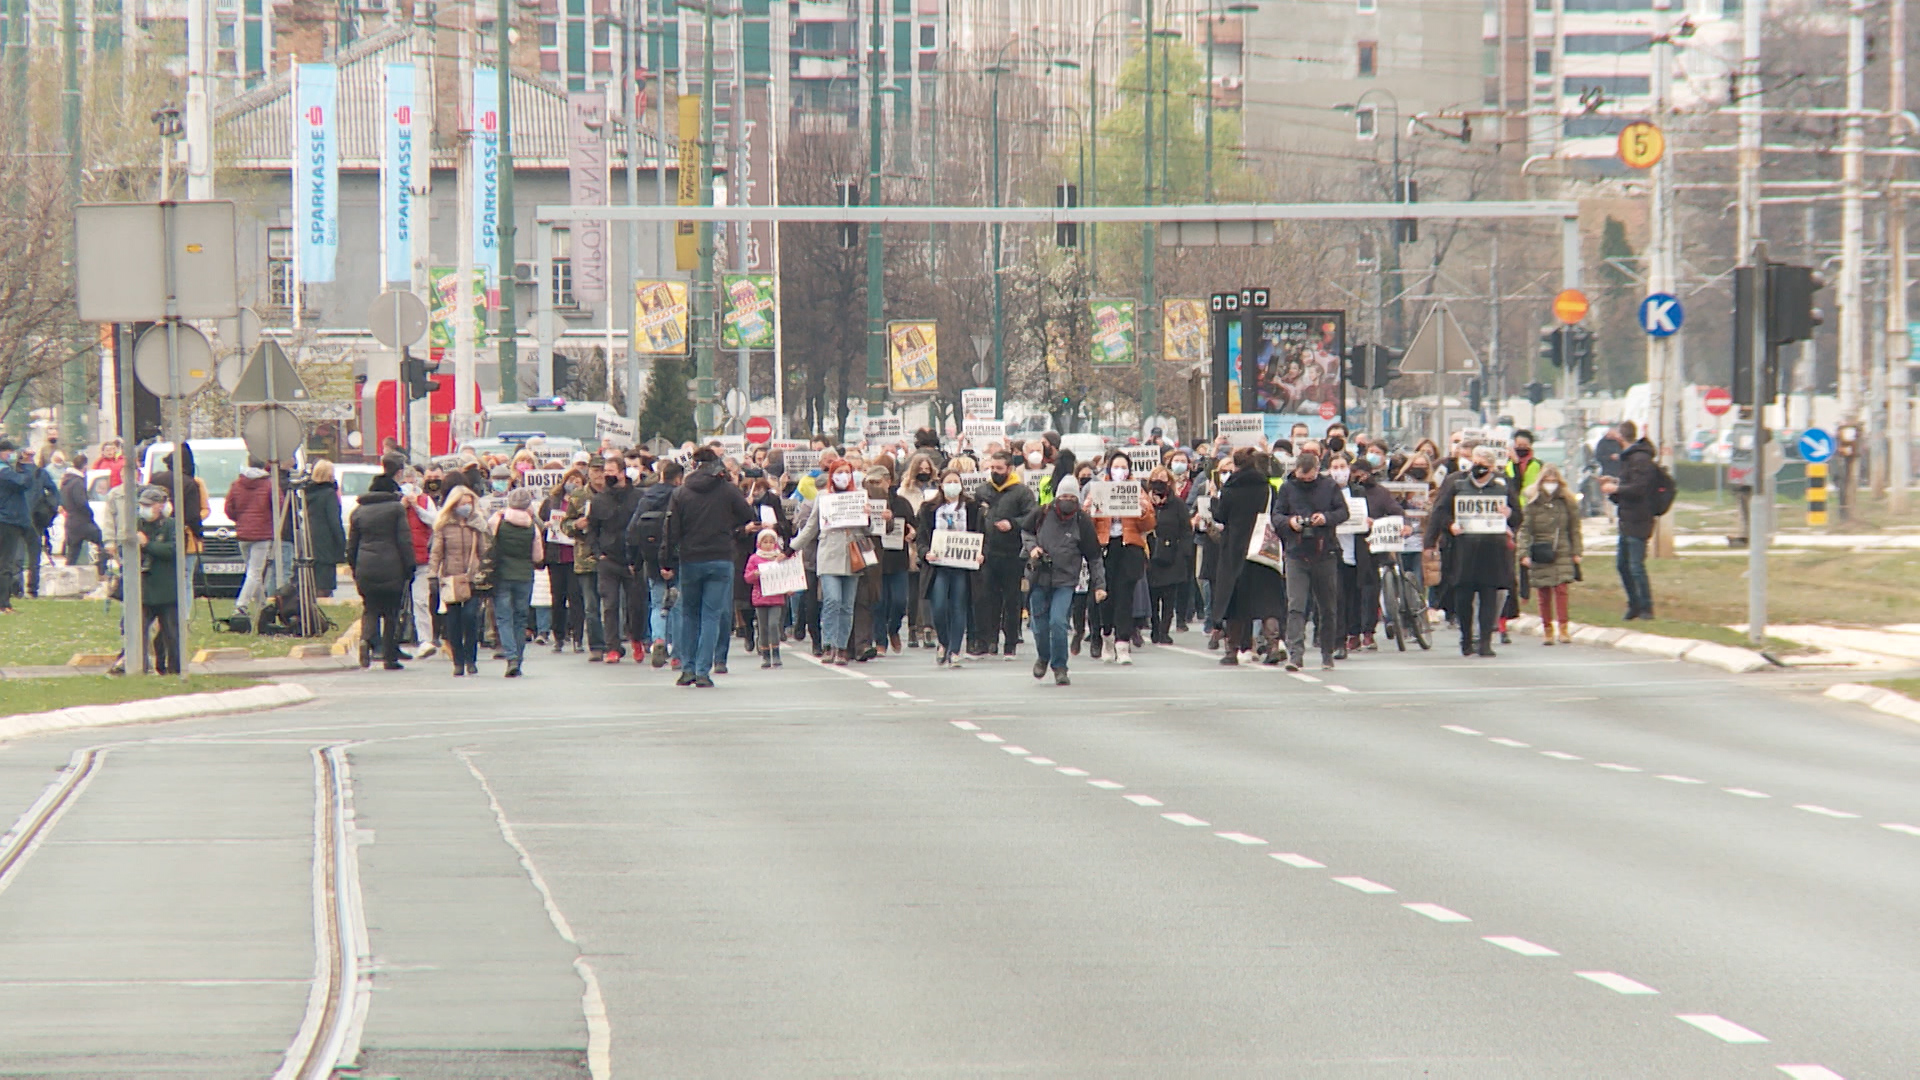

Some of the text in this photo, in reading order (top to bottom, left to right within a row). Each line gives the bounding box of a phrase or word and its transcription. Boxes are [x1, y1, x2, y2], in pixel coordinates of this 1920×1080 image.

[1635, 133, 1648, 156] 5
[311, 129, 325, 244] SPARKASSE
[398, 129, 411, 240] SPARKASSE
[483, 132, 497, 248] SPARKASSE
[1646, 300, 1676, 331] K
[1131, 459, 1158, 472] IVOT
[944, 546, 979, 561] ŽIVOT
[946, 535, 980, 546] BITKA ZA
